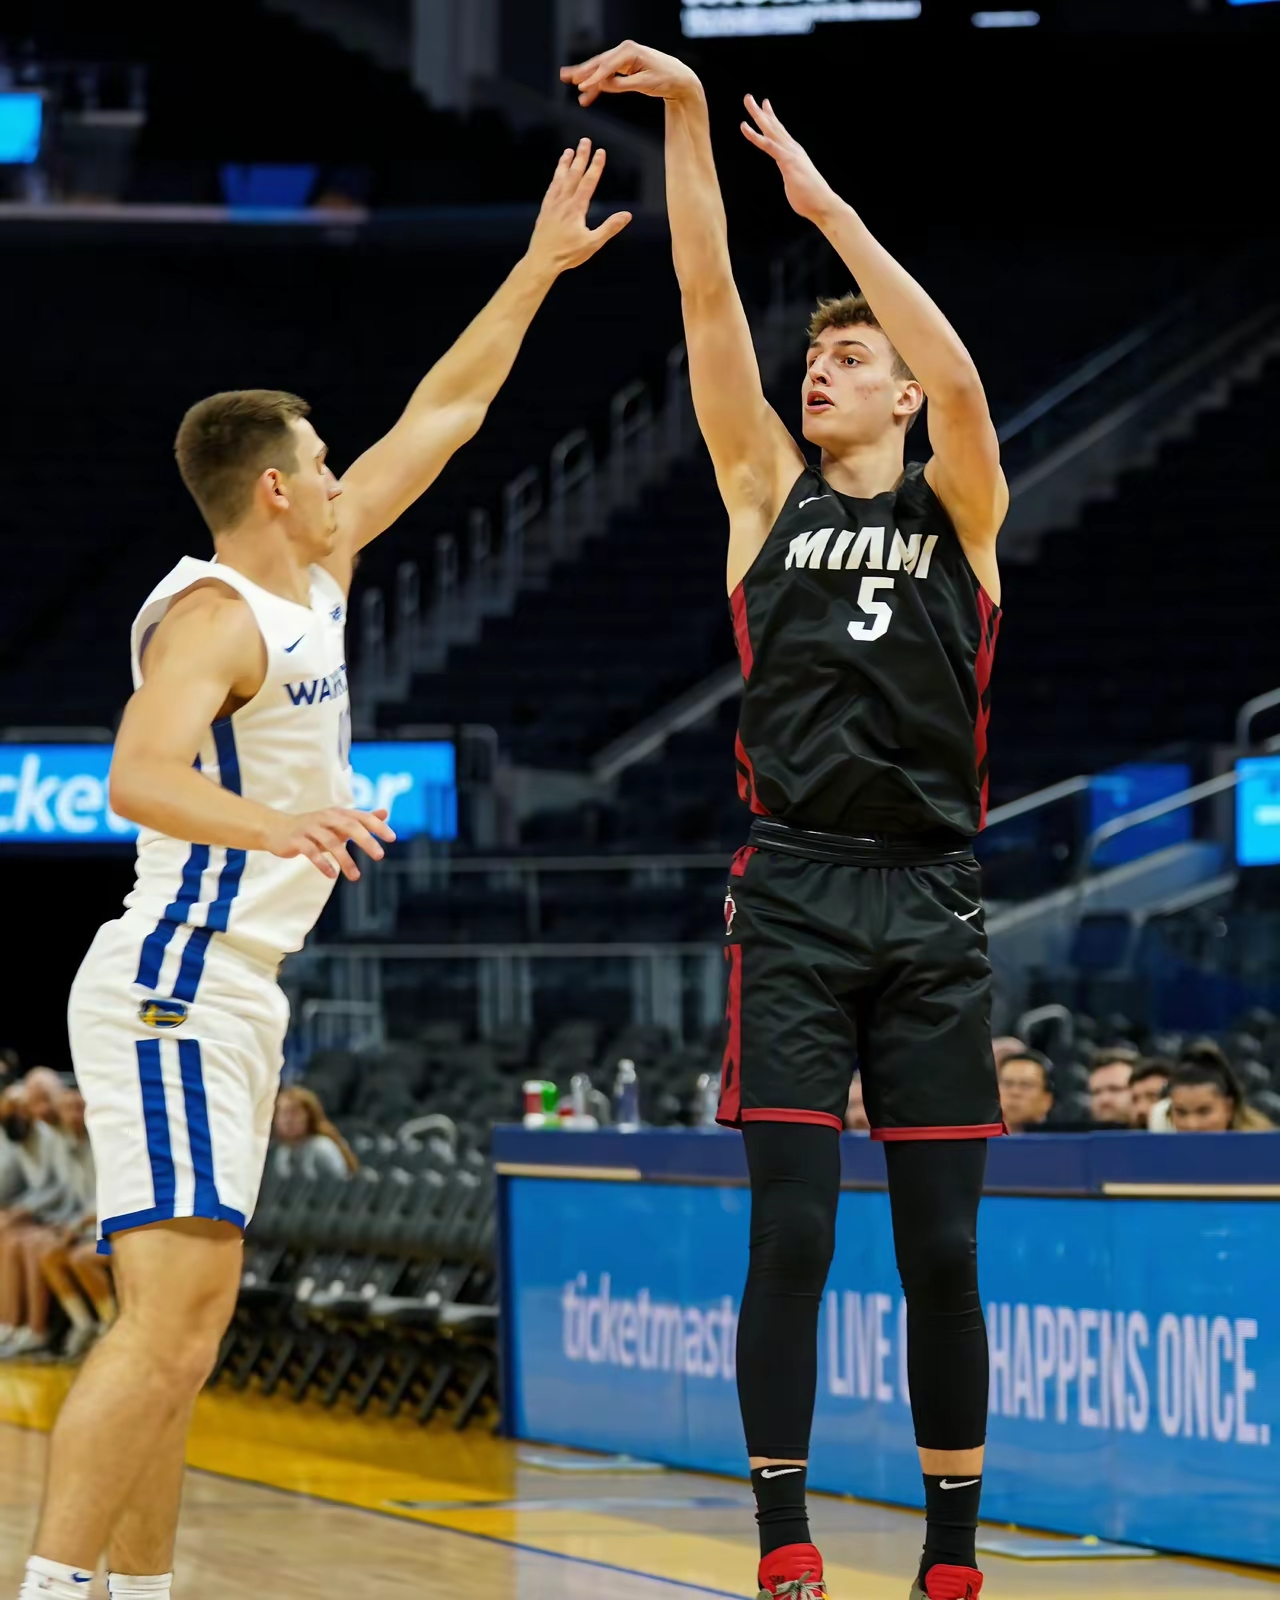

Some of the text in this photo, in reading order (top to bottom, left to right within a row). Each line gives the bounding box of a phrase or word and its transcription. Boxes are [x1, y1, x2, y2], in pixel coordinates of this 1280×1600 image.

[847, 576, 895, 642] 5
[282, 664, 347, 706] WAR
[561, 1271, 738, 1381] ticketmast
[826, 1290, 893, 1402] LIVE
[986, 1301, 1150, 1432] HAPPENS
[1156, 1312, 1270, 1446] ONCE.
